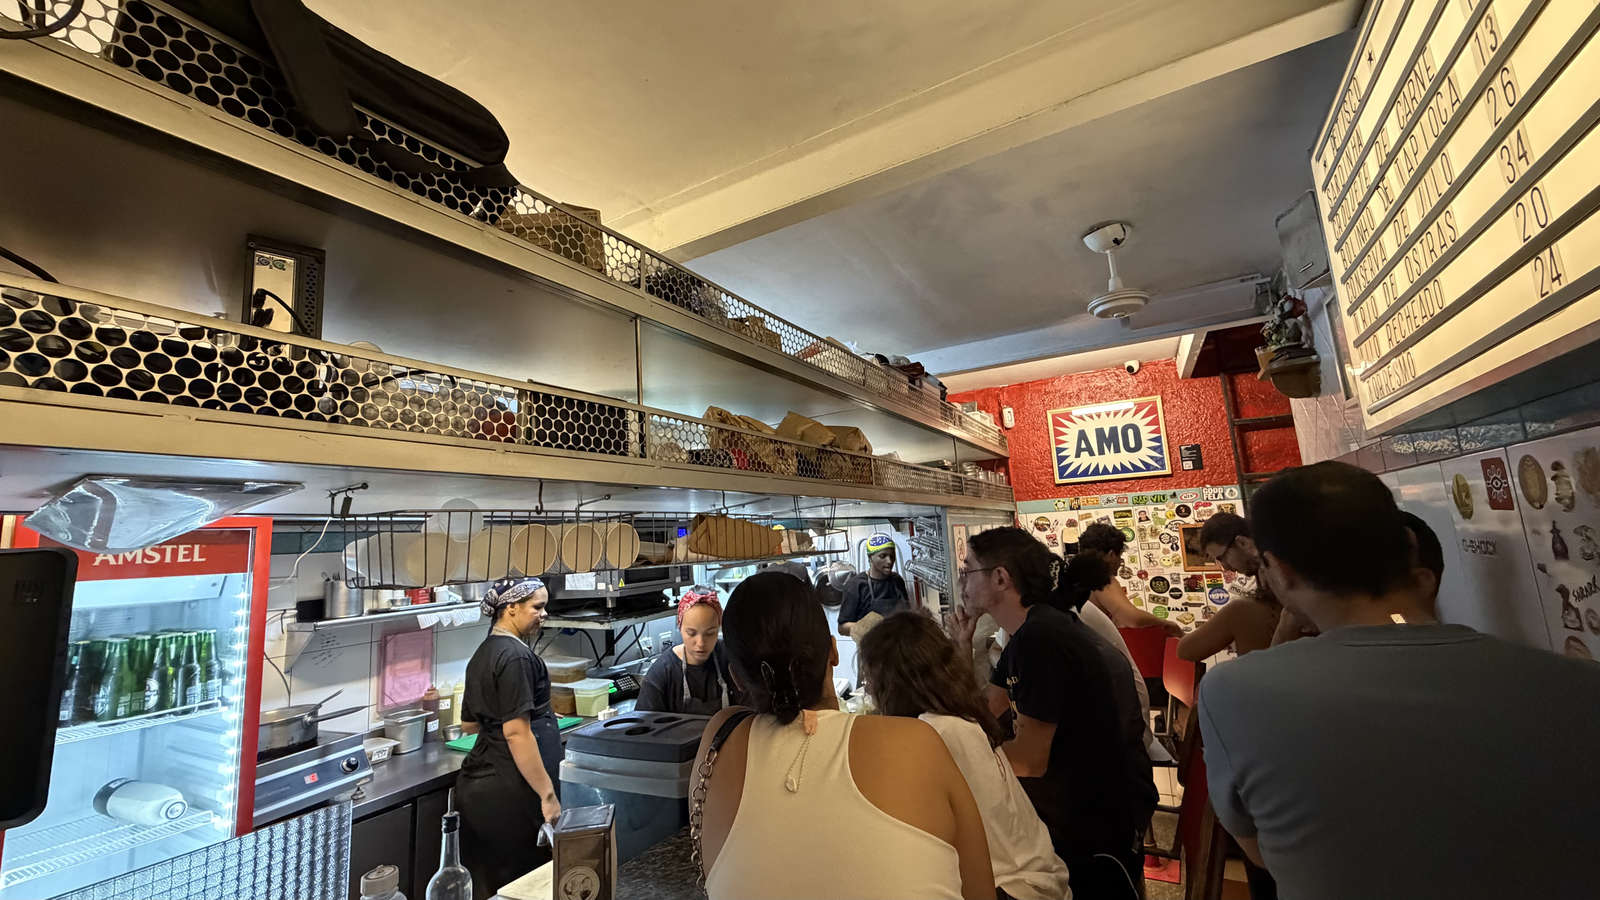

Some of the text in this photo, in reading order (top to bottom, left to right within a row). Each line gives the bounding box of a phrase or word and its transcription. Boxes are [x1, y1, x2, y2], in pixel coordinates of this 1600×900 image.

[1327, 127, 1363, 209] SARDINHA
[1330, 76, 1361, 157] PETISCO
[1333, 46, 1434, 240] CROQUETE DE CARNE
[1341, 13, 1499, 271] BOLINHO DE TAPIOCA 13
[1346, 66, 1516, 304] CONSERVA DE JILO 26
[1353, 129, 1529, 334] TRIO DE OSTRAS 34
[1386, 279, 1444, 349] RECHEADO
[1516, 186, 1548, 243] 20
[1367, 246, 1561, 402] TORRESMO 24
[1075, 423, 1143, 458] AMO
[92, 543, 206, 566] AMSTEL
